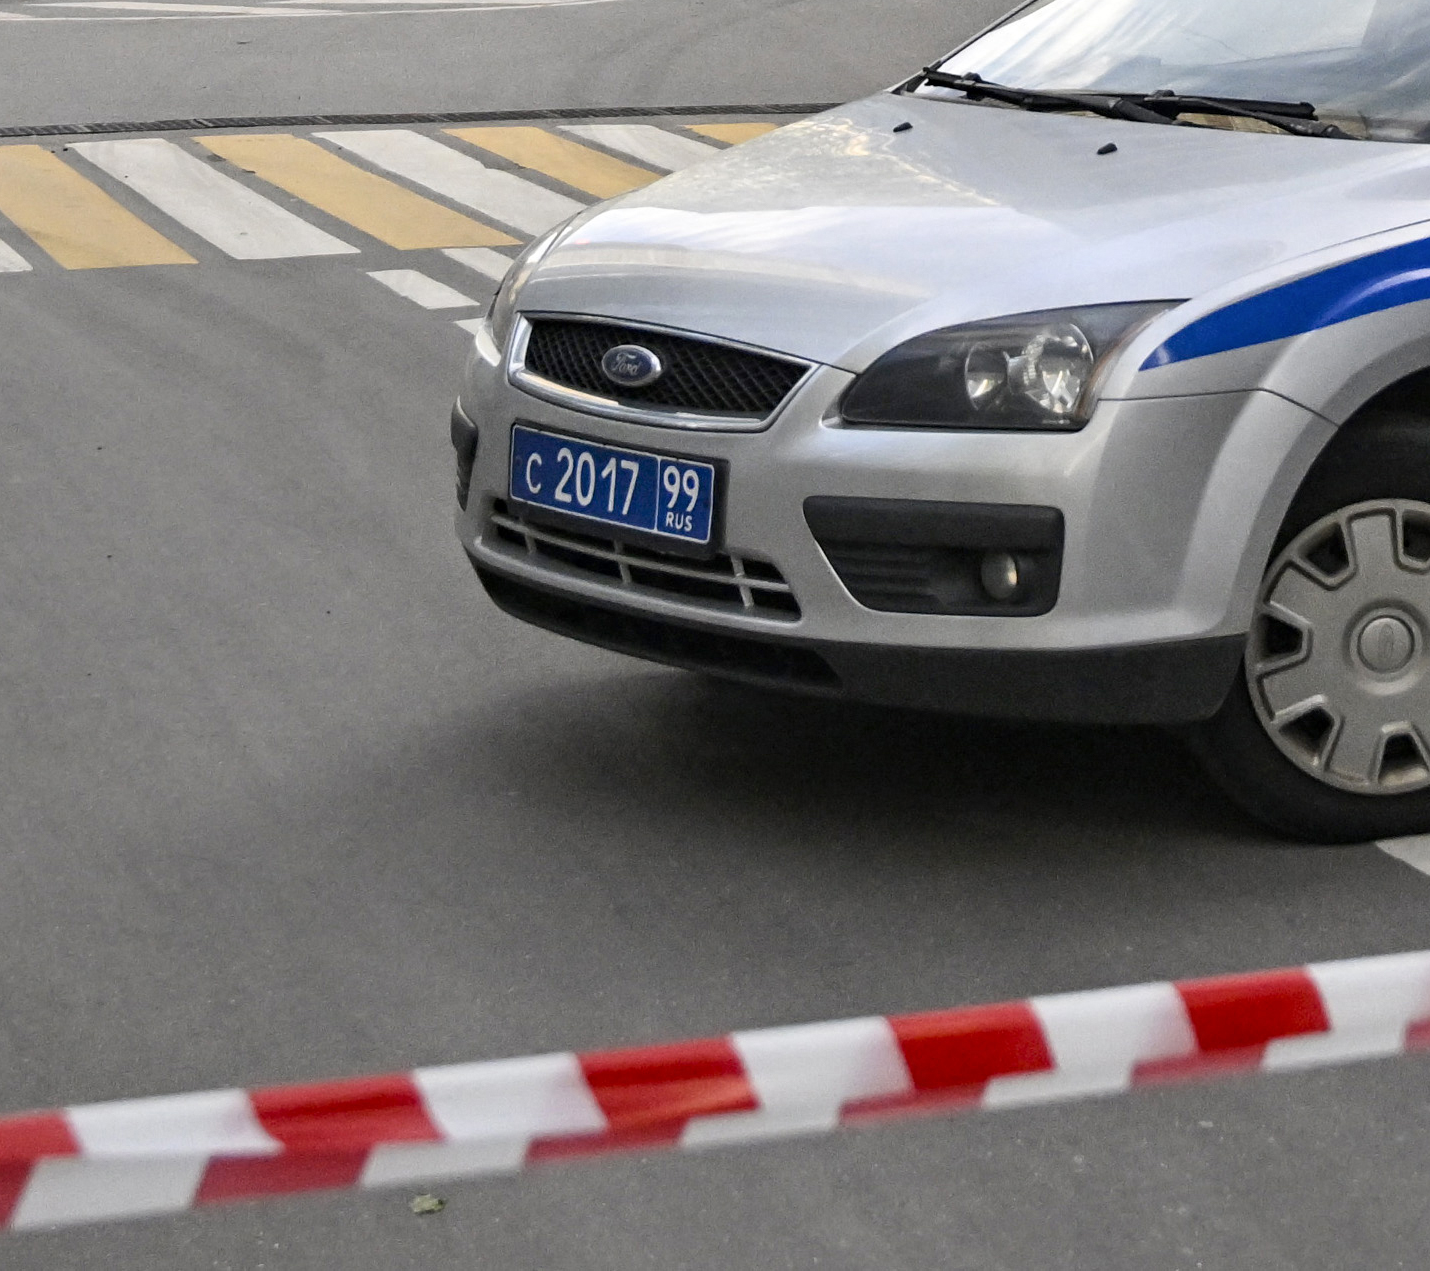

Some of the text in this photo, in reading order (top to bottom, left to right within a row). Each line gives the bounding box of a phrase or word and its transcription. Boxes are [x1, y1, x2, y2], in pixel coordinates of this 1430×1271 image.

[612, 353, 640, 375] Ford
[554, 447, 640, 516] 2017
[663, 465, 700, 512] 99
[665, 511, 693, 532] RUS
